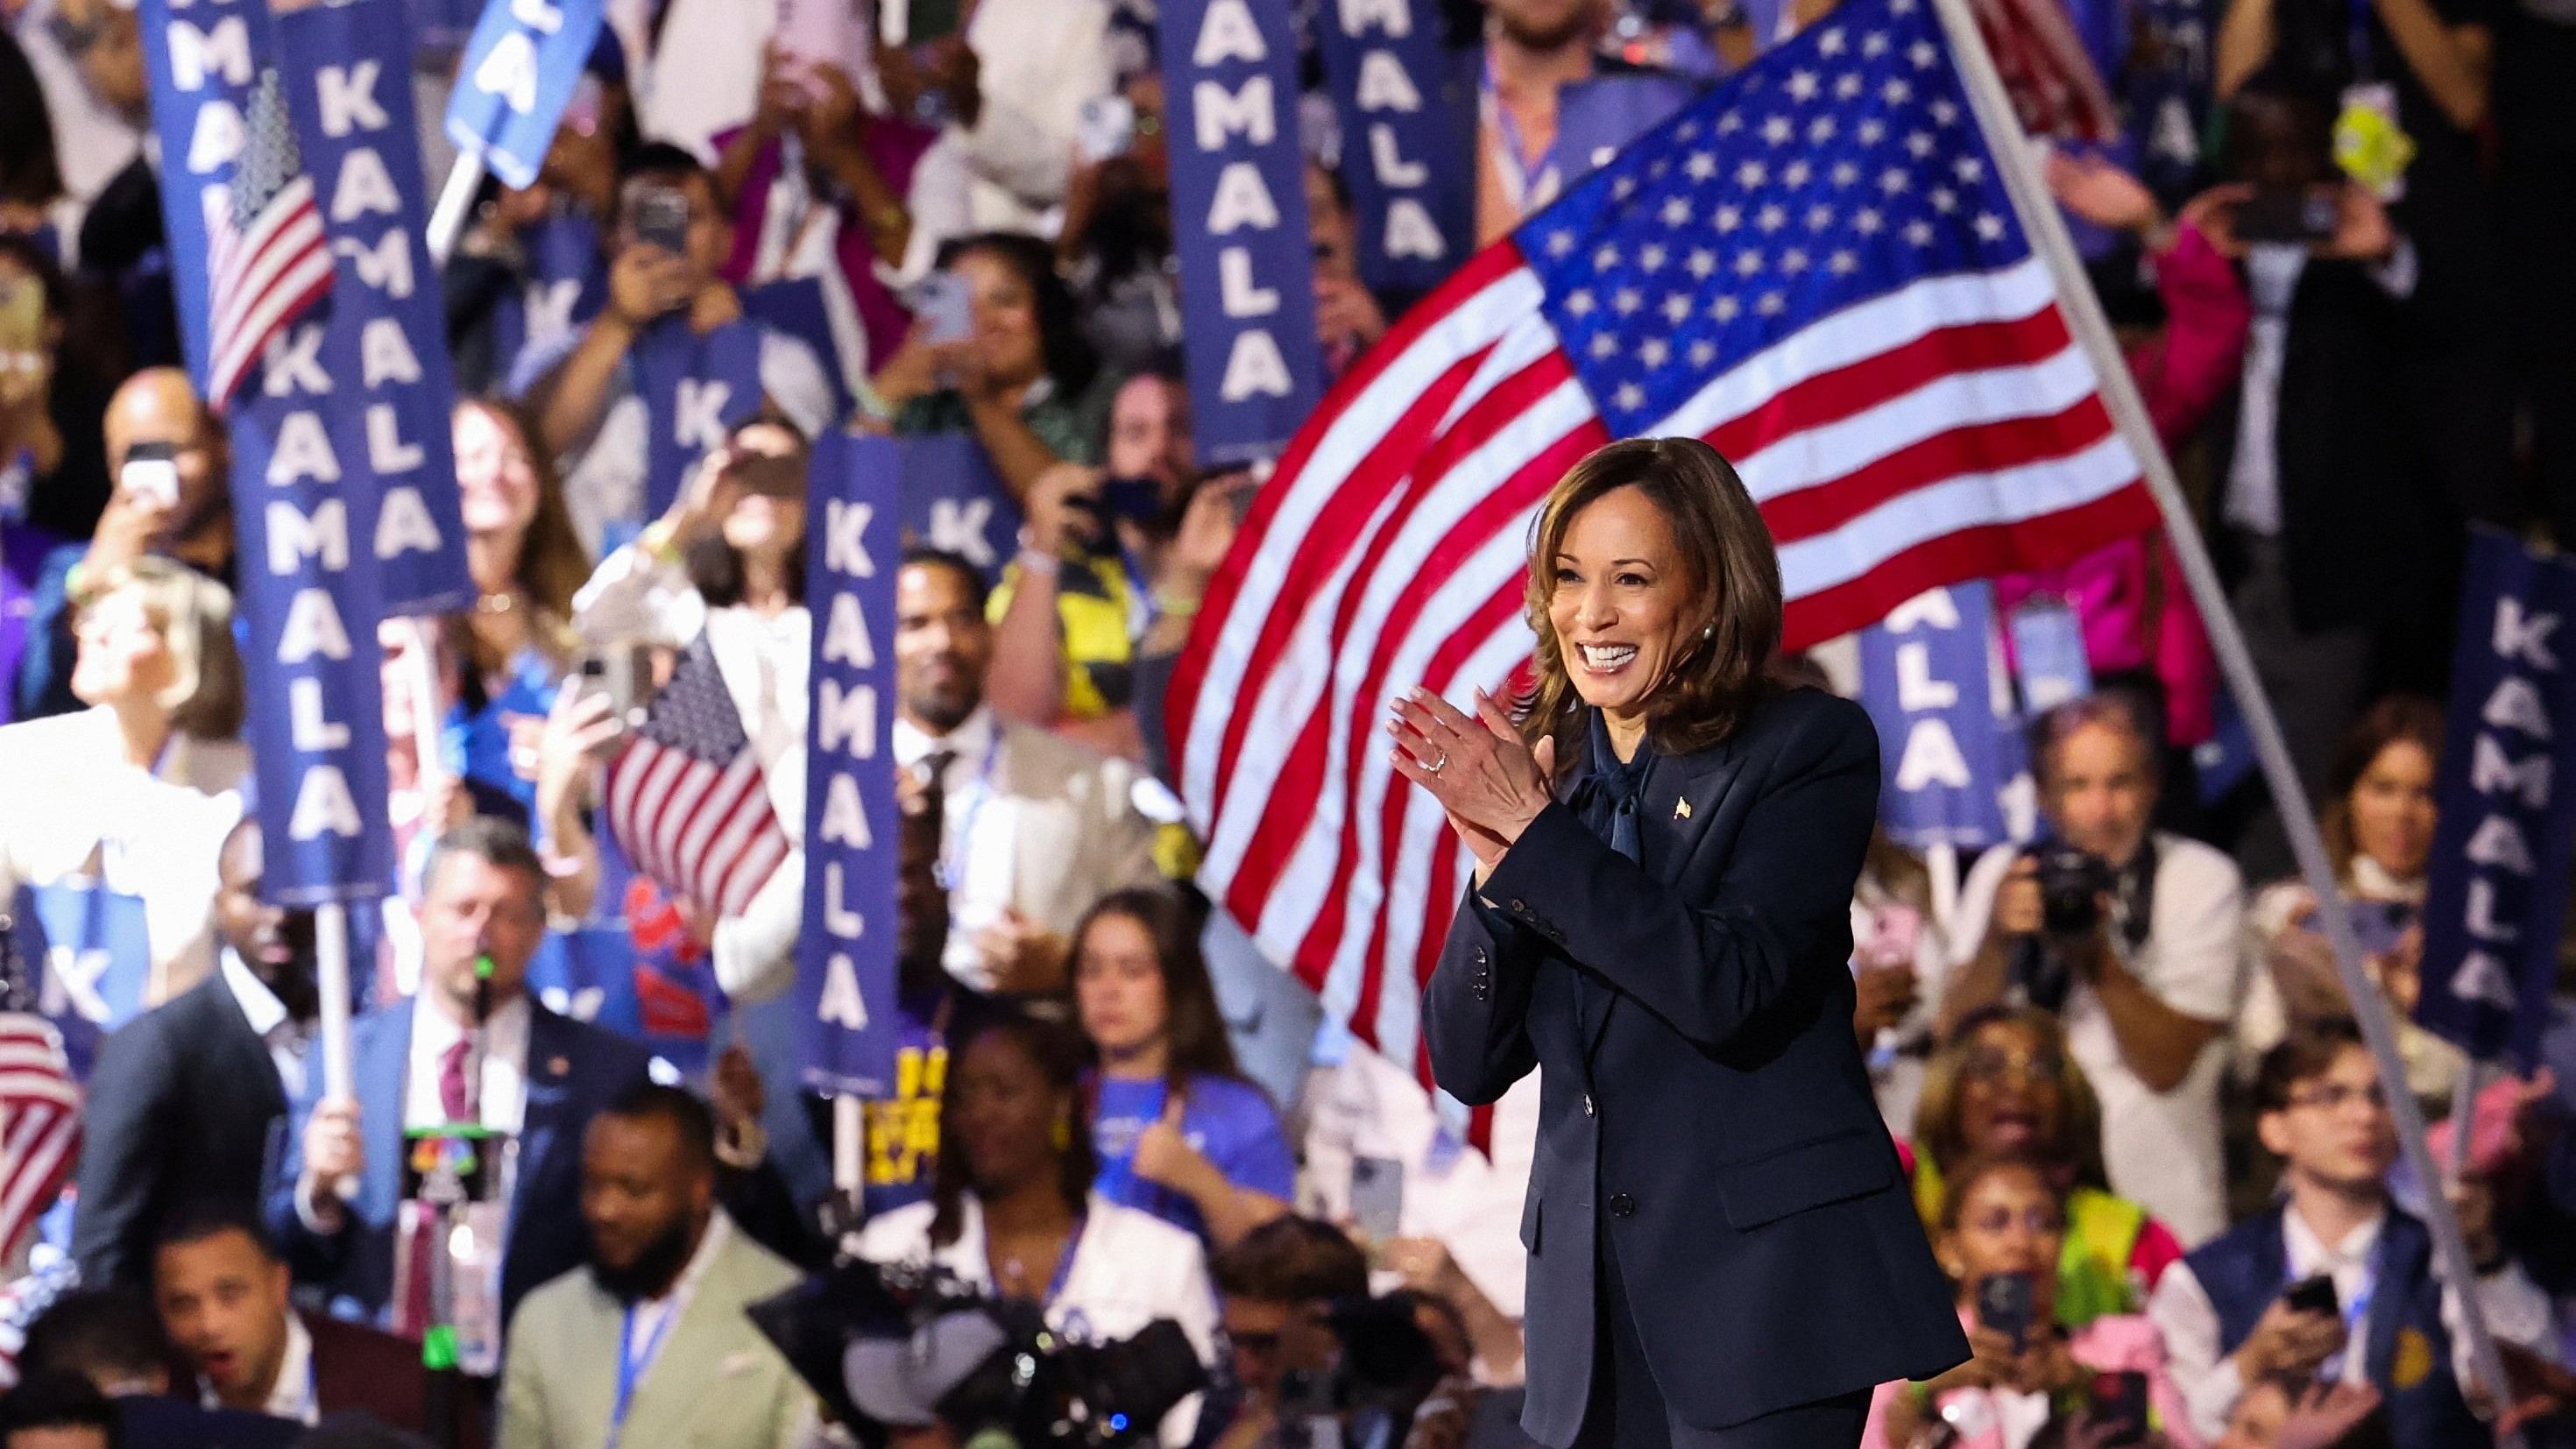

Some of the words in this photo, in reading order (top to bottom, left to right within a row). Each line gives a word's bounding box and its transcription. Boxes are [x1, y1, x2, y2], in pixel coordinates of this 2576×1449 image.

[315, 58, 442, 559] KAMALA
[264, 322, 363, 841] KAMALA
[818, 496, 877, 1030] KAMALA
[2451, 594, 2561, 1011] KAMALA
